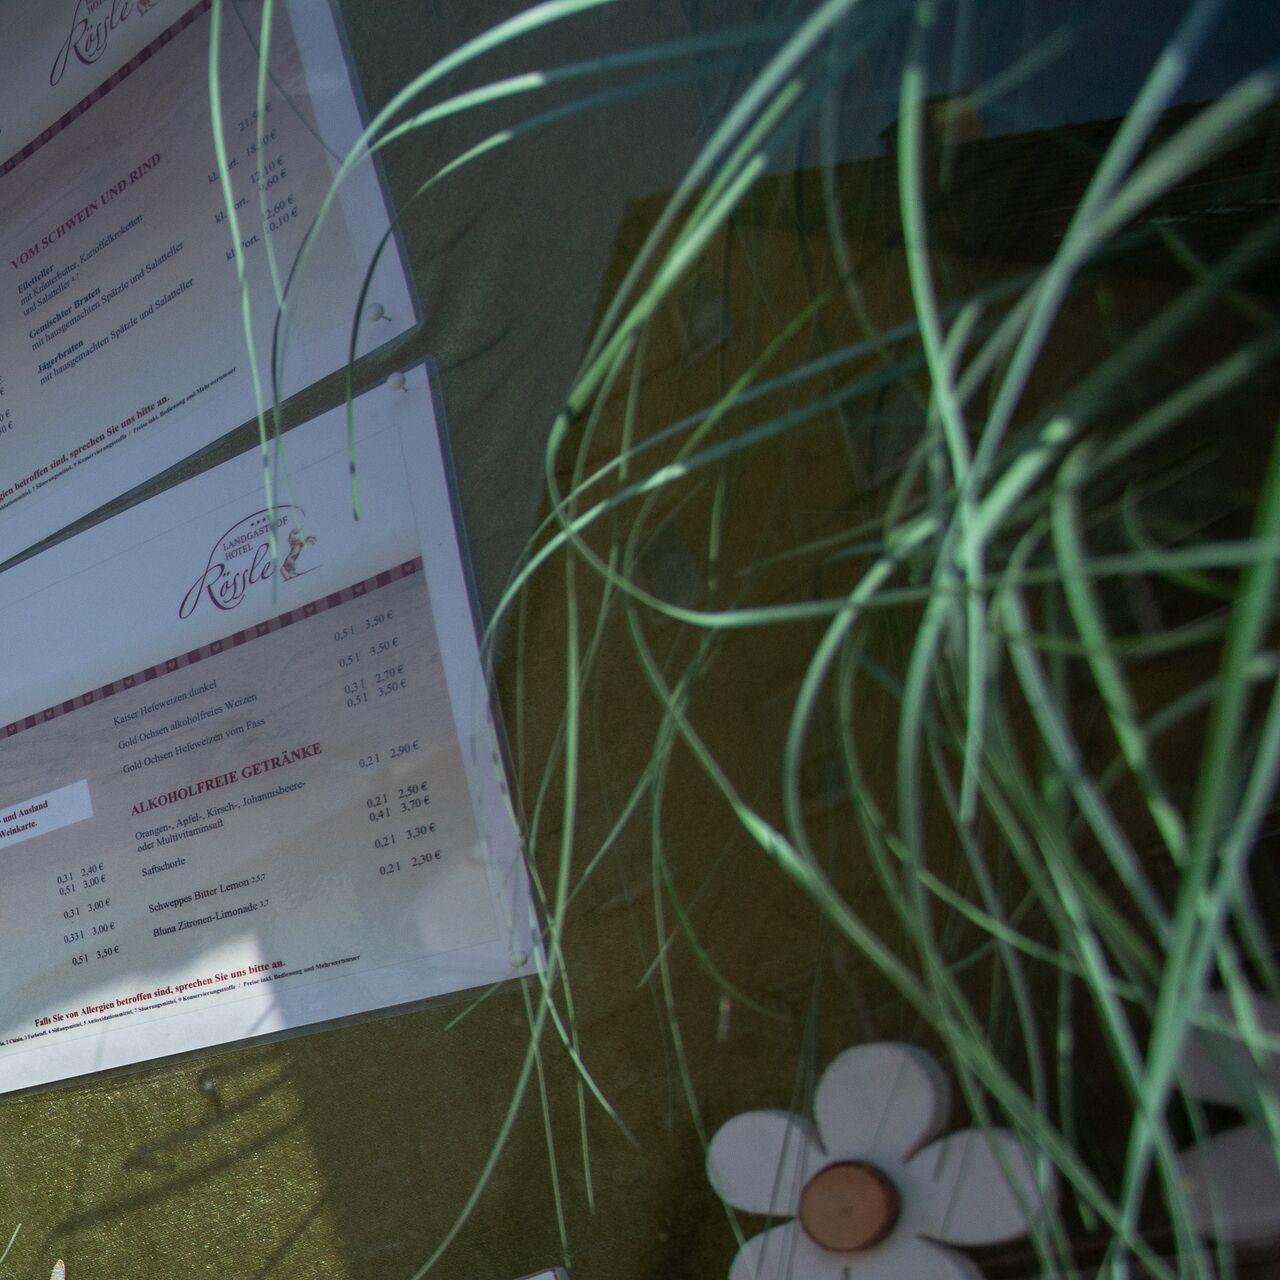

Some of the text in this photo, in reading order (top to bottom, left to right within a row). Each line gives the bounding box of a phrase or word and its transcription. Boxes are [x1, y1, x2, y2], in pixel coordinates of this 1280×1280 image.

[11, 152, 161, 271] VOM SCHWEIN UND RIND
[17, 264, 54, 294] Filetteller
[23, 279, 70, 317] und Salatteller
[32, 243, 185, 352] mit hausgemachten Spätzle und Salatteller
[28, 287, 100, 340] Gemischter Braten
[40, 280, 194, 386] mit hausgemachten Spätzle und Salatteller
[36, 339, 83, 374] Jägerbraten
[13, 467, 47, 492] betroffen
[48, 455, 67, 471] sind,
[68, 434, 103, 459] sprechen
[103, 426, 117, 438] Sie
[118, 416, 134, 429] uns
[134, 404, 155, 420] bitte
[224, 543, 254, 562] HOTEL
[113, 679, 217, 727] Kaiser Hefeweizen dunkel
[118, 694, 257, 750] Gold Ochsen alkoholfreies Weizen
[122, 718, 266, 774] Gold Ochsen Hefeweizen vom Fass
[129, 742, 321, 816] ALKOHOLFREIE GETRÄNKE
[241, 782, 305, 807] Johannisbeere-
[4, 811, 18, 823] und
[18, 800, 47, 818] Ausland
[137, 819, 224, 853] oder Multivitaminsaft
[141, 857, 186, 877] Saftschorle
[148, 880, 250, 913] Schweppes Bitter Lemon
[153, 903, 258, 937] Bluna Zitronen-Limonade
[34, 961, 285, 1027] Falls Sie von Allergien betroffen sind, sprechen Sie uns bitte an.
